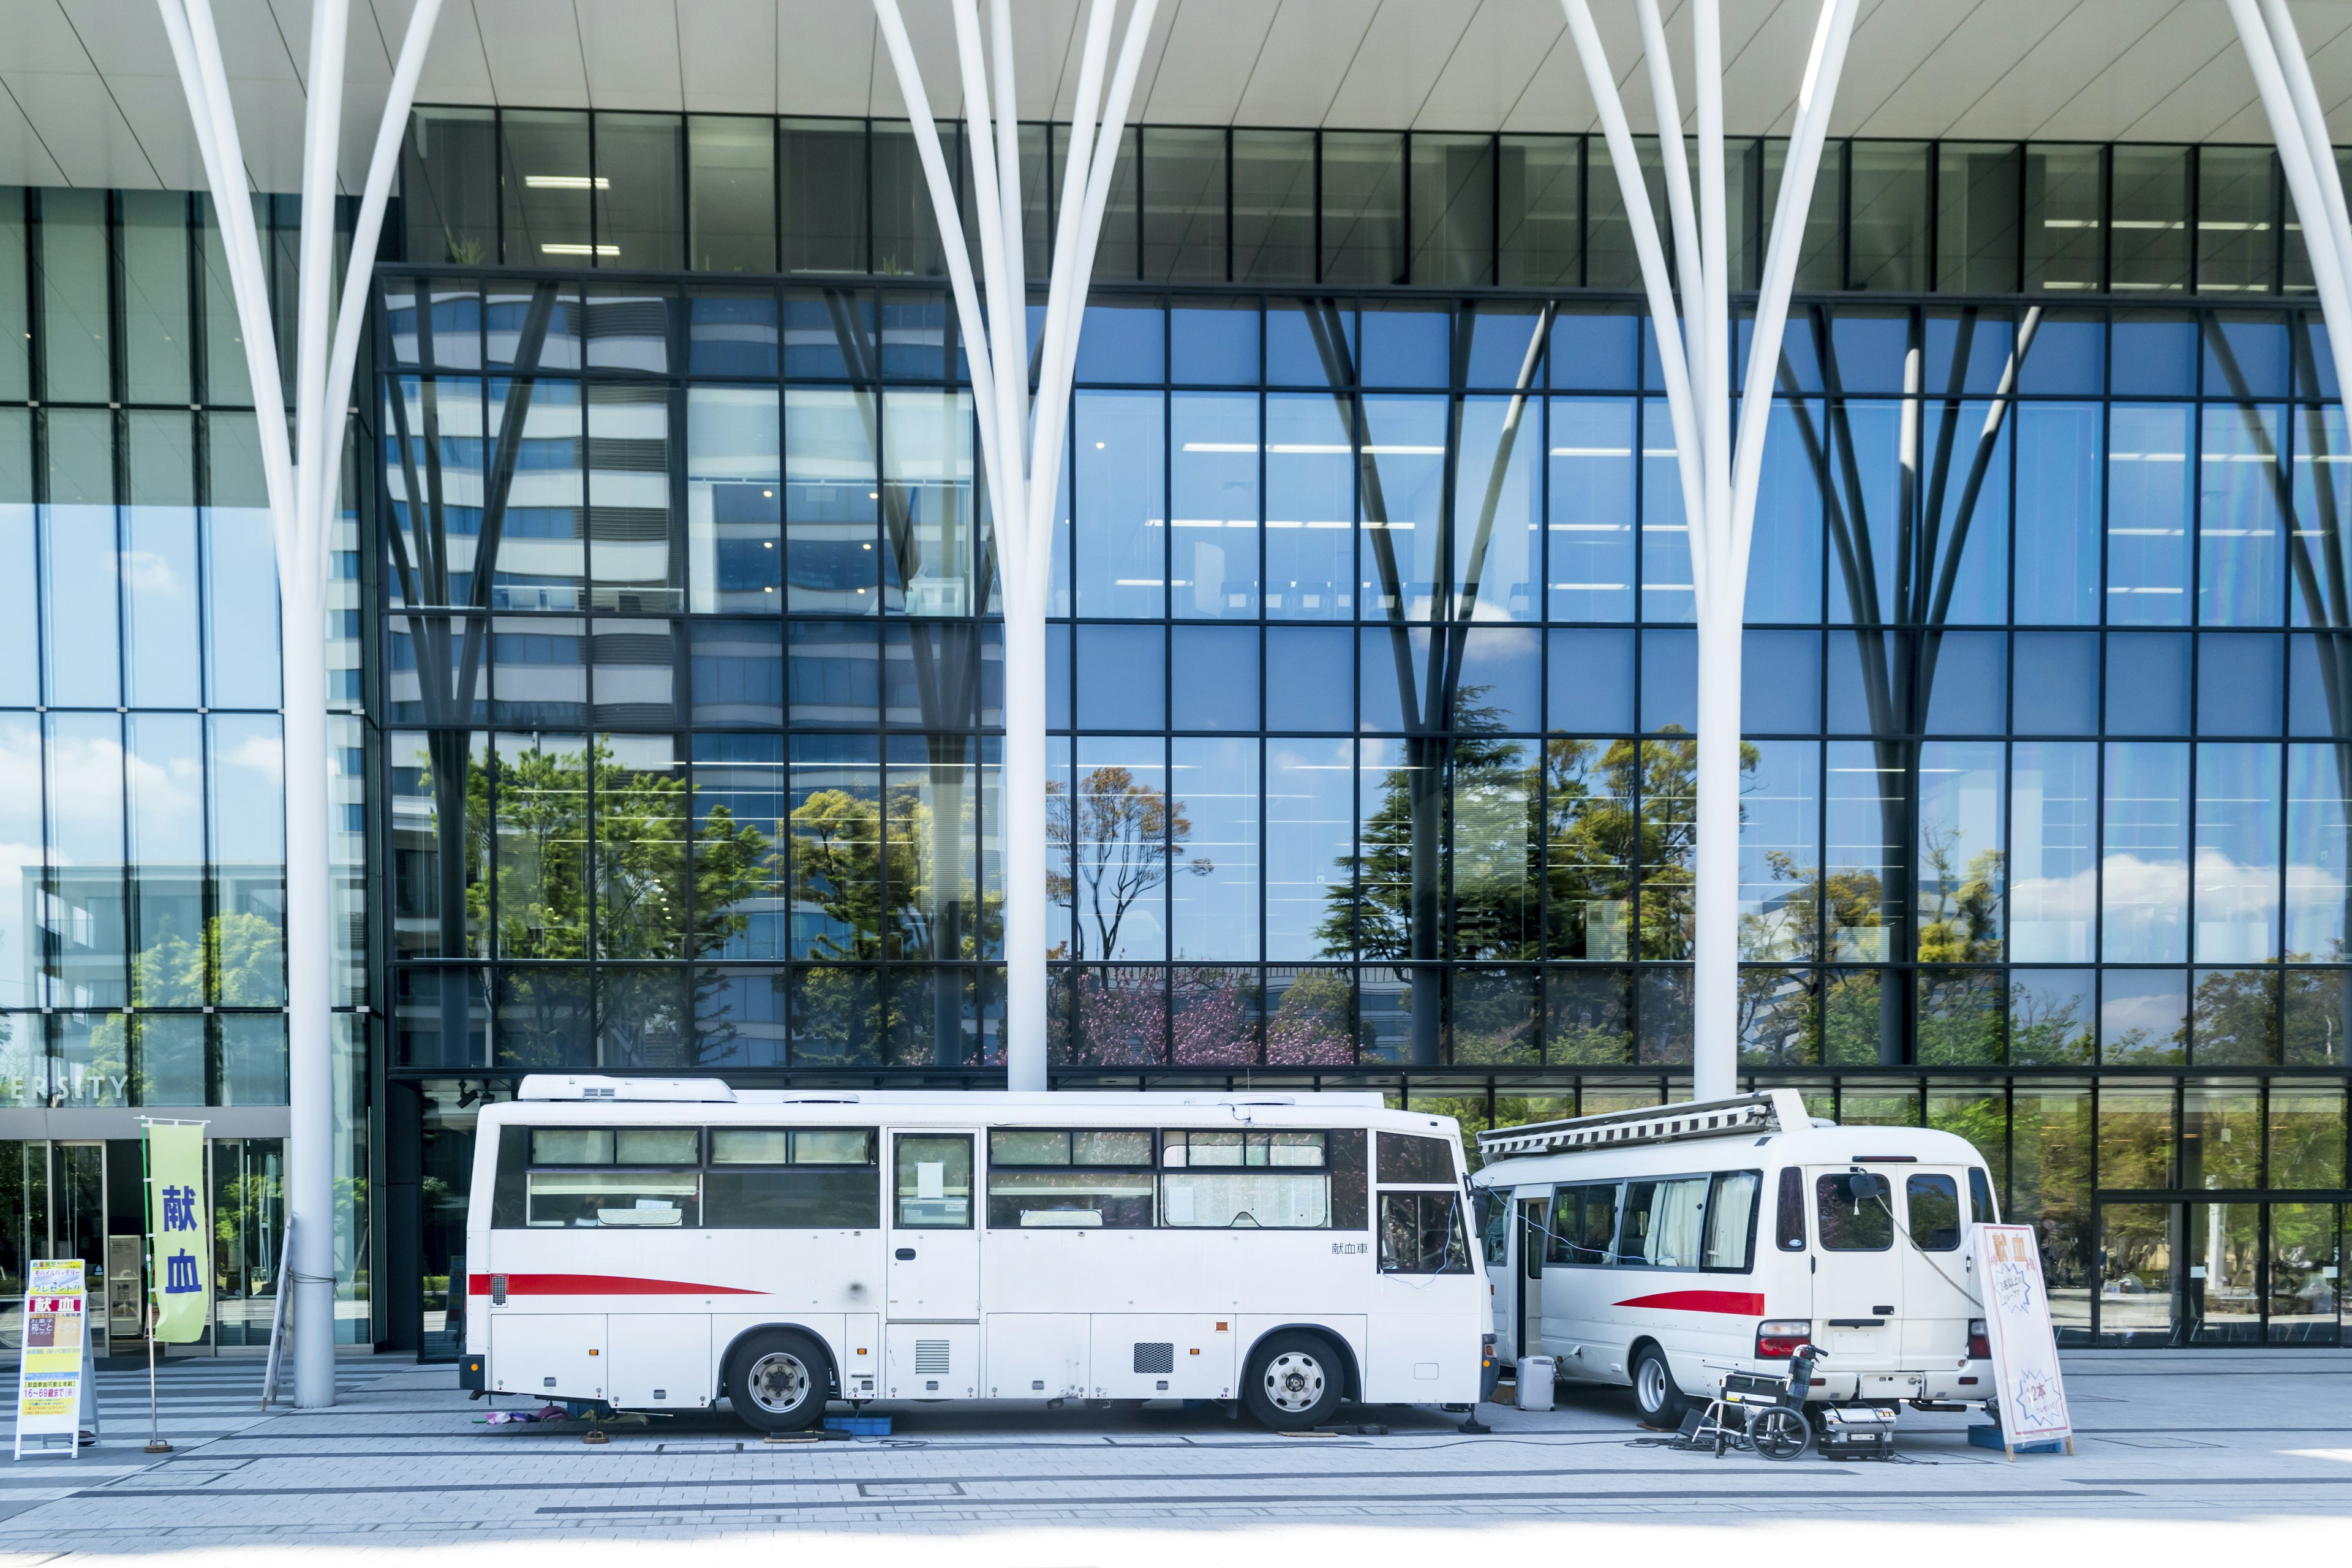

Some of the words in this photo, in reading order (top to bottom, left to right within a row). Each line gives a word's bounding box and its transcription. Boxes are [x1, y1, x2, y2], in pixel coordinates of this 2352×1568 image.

[0, 1075, 128, 1100] ERSITY
[162, 1185, 202, 1294] 献血
[1332, 1242, 1368, 1255] 献血車
[1992, 1232, 2027, 1262] 献血
[34, 1297, 75, 1312] 献血
